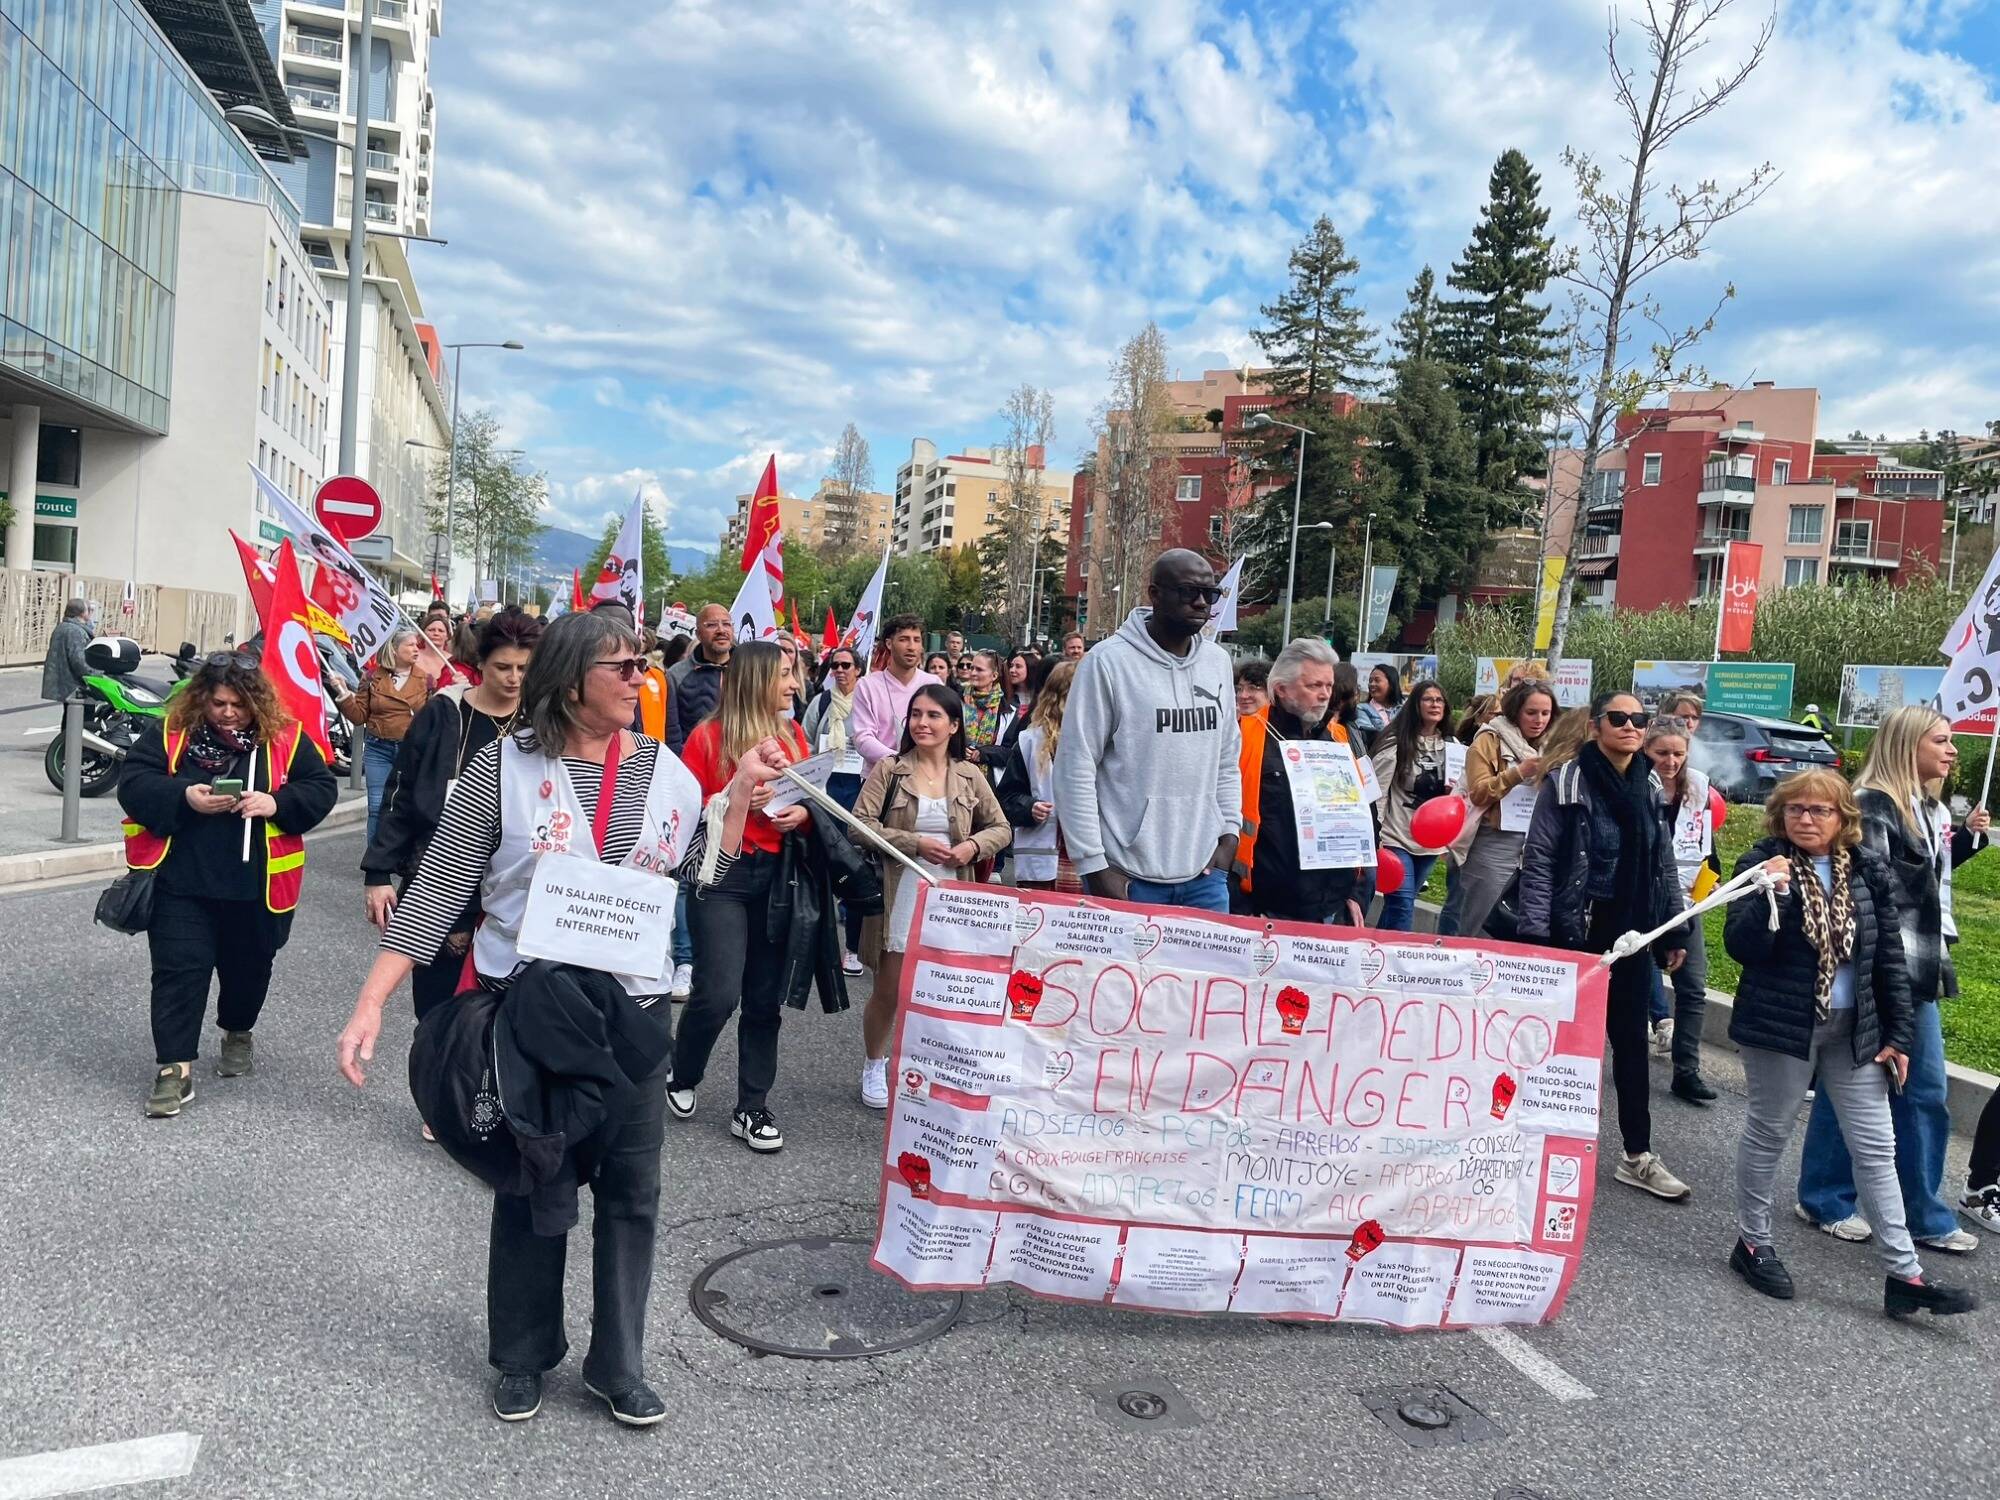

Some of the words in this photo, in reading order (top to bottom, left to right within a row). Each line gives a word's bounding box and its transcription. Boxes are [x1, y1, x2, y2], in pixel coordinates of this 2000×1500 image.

[1156, 706, 1217, 733] PUMA
[550, 830, 569, 841] cgt
[532, 841, 552, 850] USD
[546, 883, 564, 895] UN
[566, 887, 614, 906] SALAIRE
[615, 895, 662, 915] DÉCENT
[940, 894, 1009, 909] ÉTABLISSEMENTS
[567, 904, 604, 919] AVANT
[607, 911, 635, 925] MON
[947, 906, 998, 919] SURBOOKÉS
[1077, 912, 1090, 920] EST
[1092, 913, 1110, 922] L'OR
[556, 917, 640, 942] ENTERREMENT
[929, 914, 969, 927] ENFANCE
[970, 921, 1012, 932] SACRIFIÉE
[1051, 920, 1108, 933] D'AUGMENTER
[1110, 926, 1124, 935] LES
[1067, 932, 1104, 943] SALAIRES
[1175, 928, 1201, 937] PREND
[1213, 933, 1228, 942] RUE
[1230, 936, 1251, 944] POUR
[1055, 942, 1112, 955] MONSEIGN'OR
[1163, 936, 1190, 946] SORTIR
[1204, 943, 1241, 954] L'IMPASSE
[1292, 941, 1313, 951] MON
[1314, 943, 1349, 955] SALAIRE
[1293, 954, 1307, 963] MA
[1308, 956, 1346, 967] BATAILLE
[1397, 951, 1425, 961] SEGUR
[1426, 952, 1448, 962] POUR
[1528, 964, 1550, 973] NOUS
[1552, 967, 1566, 975] LES
[930, 970, 963, 983] TRAVAIL
[965, 975, 995, 985] SOCIAL
[1387, 974, 1416, 984] SEGUR
[1418, 976, 1441, 986] POUR
[1443, 979, 1463, 987] TOUS
[1498, 973, 1530, 983] MOYENS
[1532, 977, 1559, 986] D'ETRE
[947, 984, 975, 994] SOLDÉ
[1511, 987, 1543, 996] HUMAIN
[916, 991, 925, 999] 50
[937, 994, 955, 1004] SUR
[956, 997, 966, 1005] LA
[968, 998, 1001, 1009] QUALITÉ
[1026, 959, 1290, 1047] SOCIAL
[921, 1037, 993, 1058] RÉORGANISATION
[994, 1051, 1005, 1059] AU
[911, 1054, 933, 1066] QUEL
[934, 1061, 970, 1078] RESPECT
[971, 1071, 998, 1082] POUR
[999, 1074, 1011, 1083] LES
[948, 1054, 977, 1068] RABAIS
[1546, 1065, 1577, 1076] SOCIAL
[935, 1071, 973, 1089] USAGERS
[1526, 1075, 1597, 1091] MEDICO-SOCIAL
[1094, 1047, 1164, 1113] EN
[1179, 1051, 1471, 1129] DANGER
[1539, 1089, 1549, 1097] TU
[1551, 1091, 1582, 1101] PERDS
[1522, 1099, 1540, 1108] TON
[1541, 1101, 1567, 1112] SANG
[1569, 1105, 1598, 1116] FROID
[904, 1113, 918, 1124] UN
[920, 1117, 956, 1141] SALAIRE
[957, 1131, 997, 1148] DÉCENT
[922, 1132, 950, 1149] AVANT
[950, 1145, 973, 1156] MON
[913, 1141, 979, 1170] ENTERREMENT
[1225, 1151, 1359, 1188] MONTJOYE
[1472, 1178, 1494, 1195] 06
[1328, 1193, 1375, 1222] ALC
[1016, 1223, 1041, 1233] REFUS
[1043, 1229, 1055, 1237] DU
[1057, 1232, 1101, 1245] CHANTAGE
[1027, 1232, 1049, 1245] DANS
[1062, 1243, 1086, 1253] CCUE
[1023, 1240, 1032, 1248] ET
[1033, 1244, 1067, 1259] REPRISE
[1069, 1254, 1085, 1263] DES
[1010, 1248, 1070, 1269] NÉGOCIATIONS
[1071, 1264, 1095, 1274] DANS
[1011, 1256, 1028, 1265] NOS
[1029, 1261, 1089, 1281] CONVENTIONS
[1488, 1260, 1539, 1272] NÉGOCIATIONS
[1398, 1264, 1426, 1274] MOYENS
[1473, 1270, 1508, 1278] TOURNENT
[1519, 1274, 1540, 1282] ROND
[1402, 1275, 1420, 1283] PLUS
[1495, 1281, 1525, 1290] POGNON
[1397, 1284, 1416, 1293] QUOI
[1476, 1289, 1498, 1297] NOTRE
[1500, 1292, 1535, 1301] NOUVELLE
[1377, 1291, 1408, 1303] GAMINS
